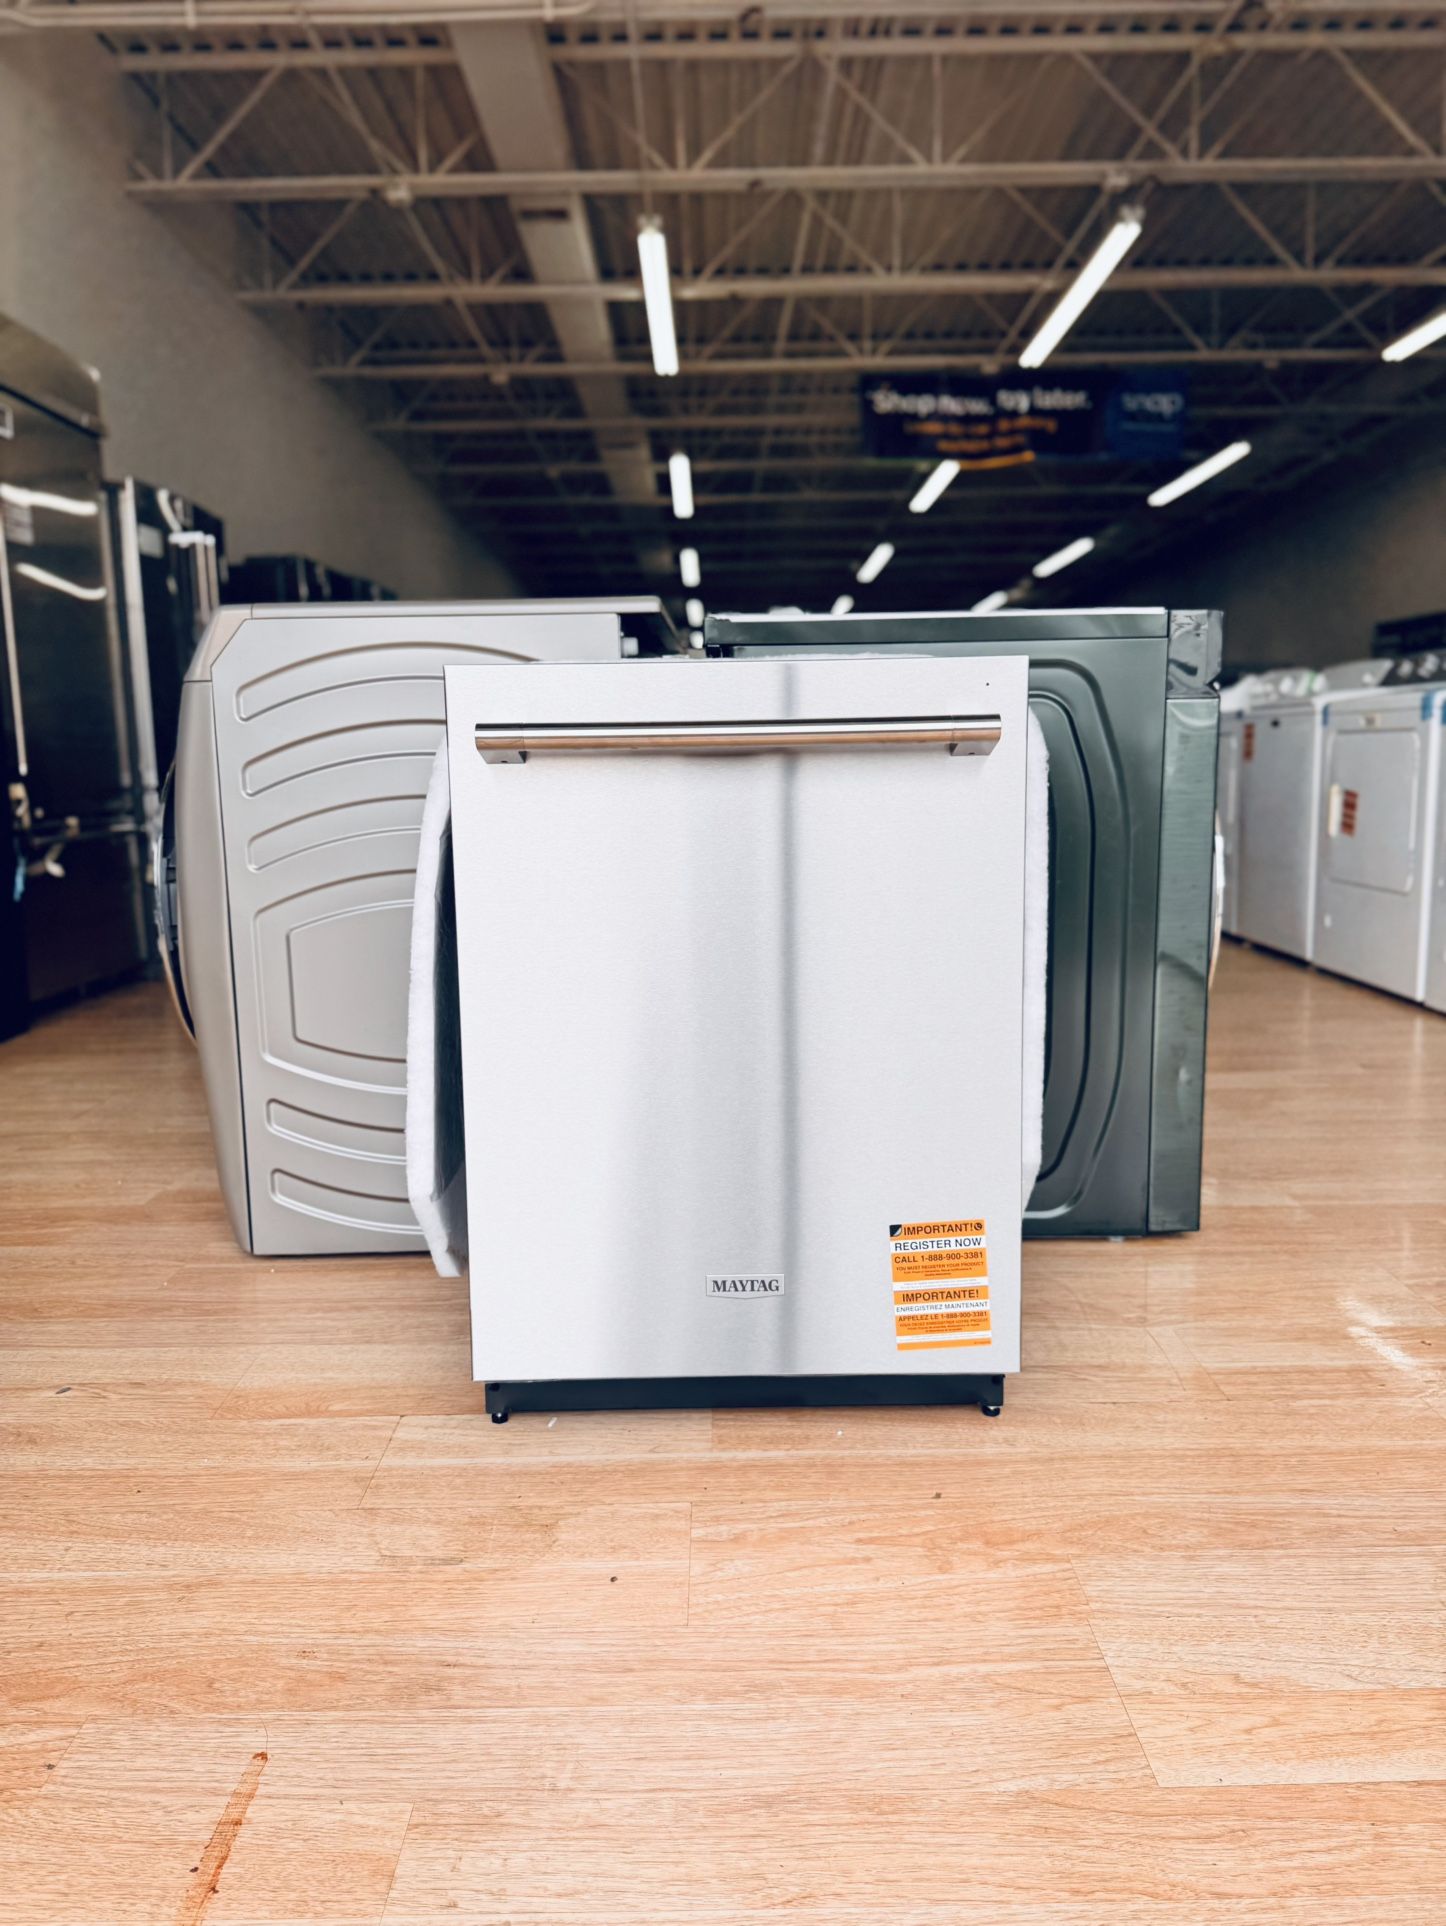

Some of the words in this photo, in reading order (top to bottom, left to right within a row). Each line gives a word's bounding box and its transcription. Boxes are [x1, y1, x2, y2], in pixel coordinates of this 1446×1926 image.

[903, 1222, 973, 1236] IMPORTANT!
[894, 1239, 952, 1252] REGISTER
[954, 1237, 982, 1248] NOW
[894, 1255, 918, 1264] CALL
[921, 1251, 984, 1262] 1-888-900-3381
[711, 1279, 779, 1292] MAYTAG
[902, 1289, 979, 1303] IMPORTANTE!
[896, 1304, 943, 1313] ENREGISTREZ
[944, 1301, 988, 1310] MAINTENANT
[898, 1314, 929, 1322] APPELEZ
